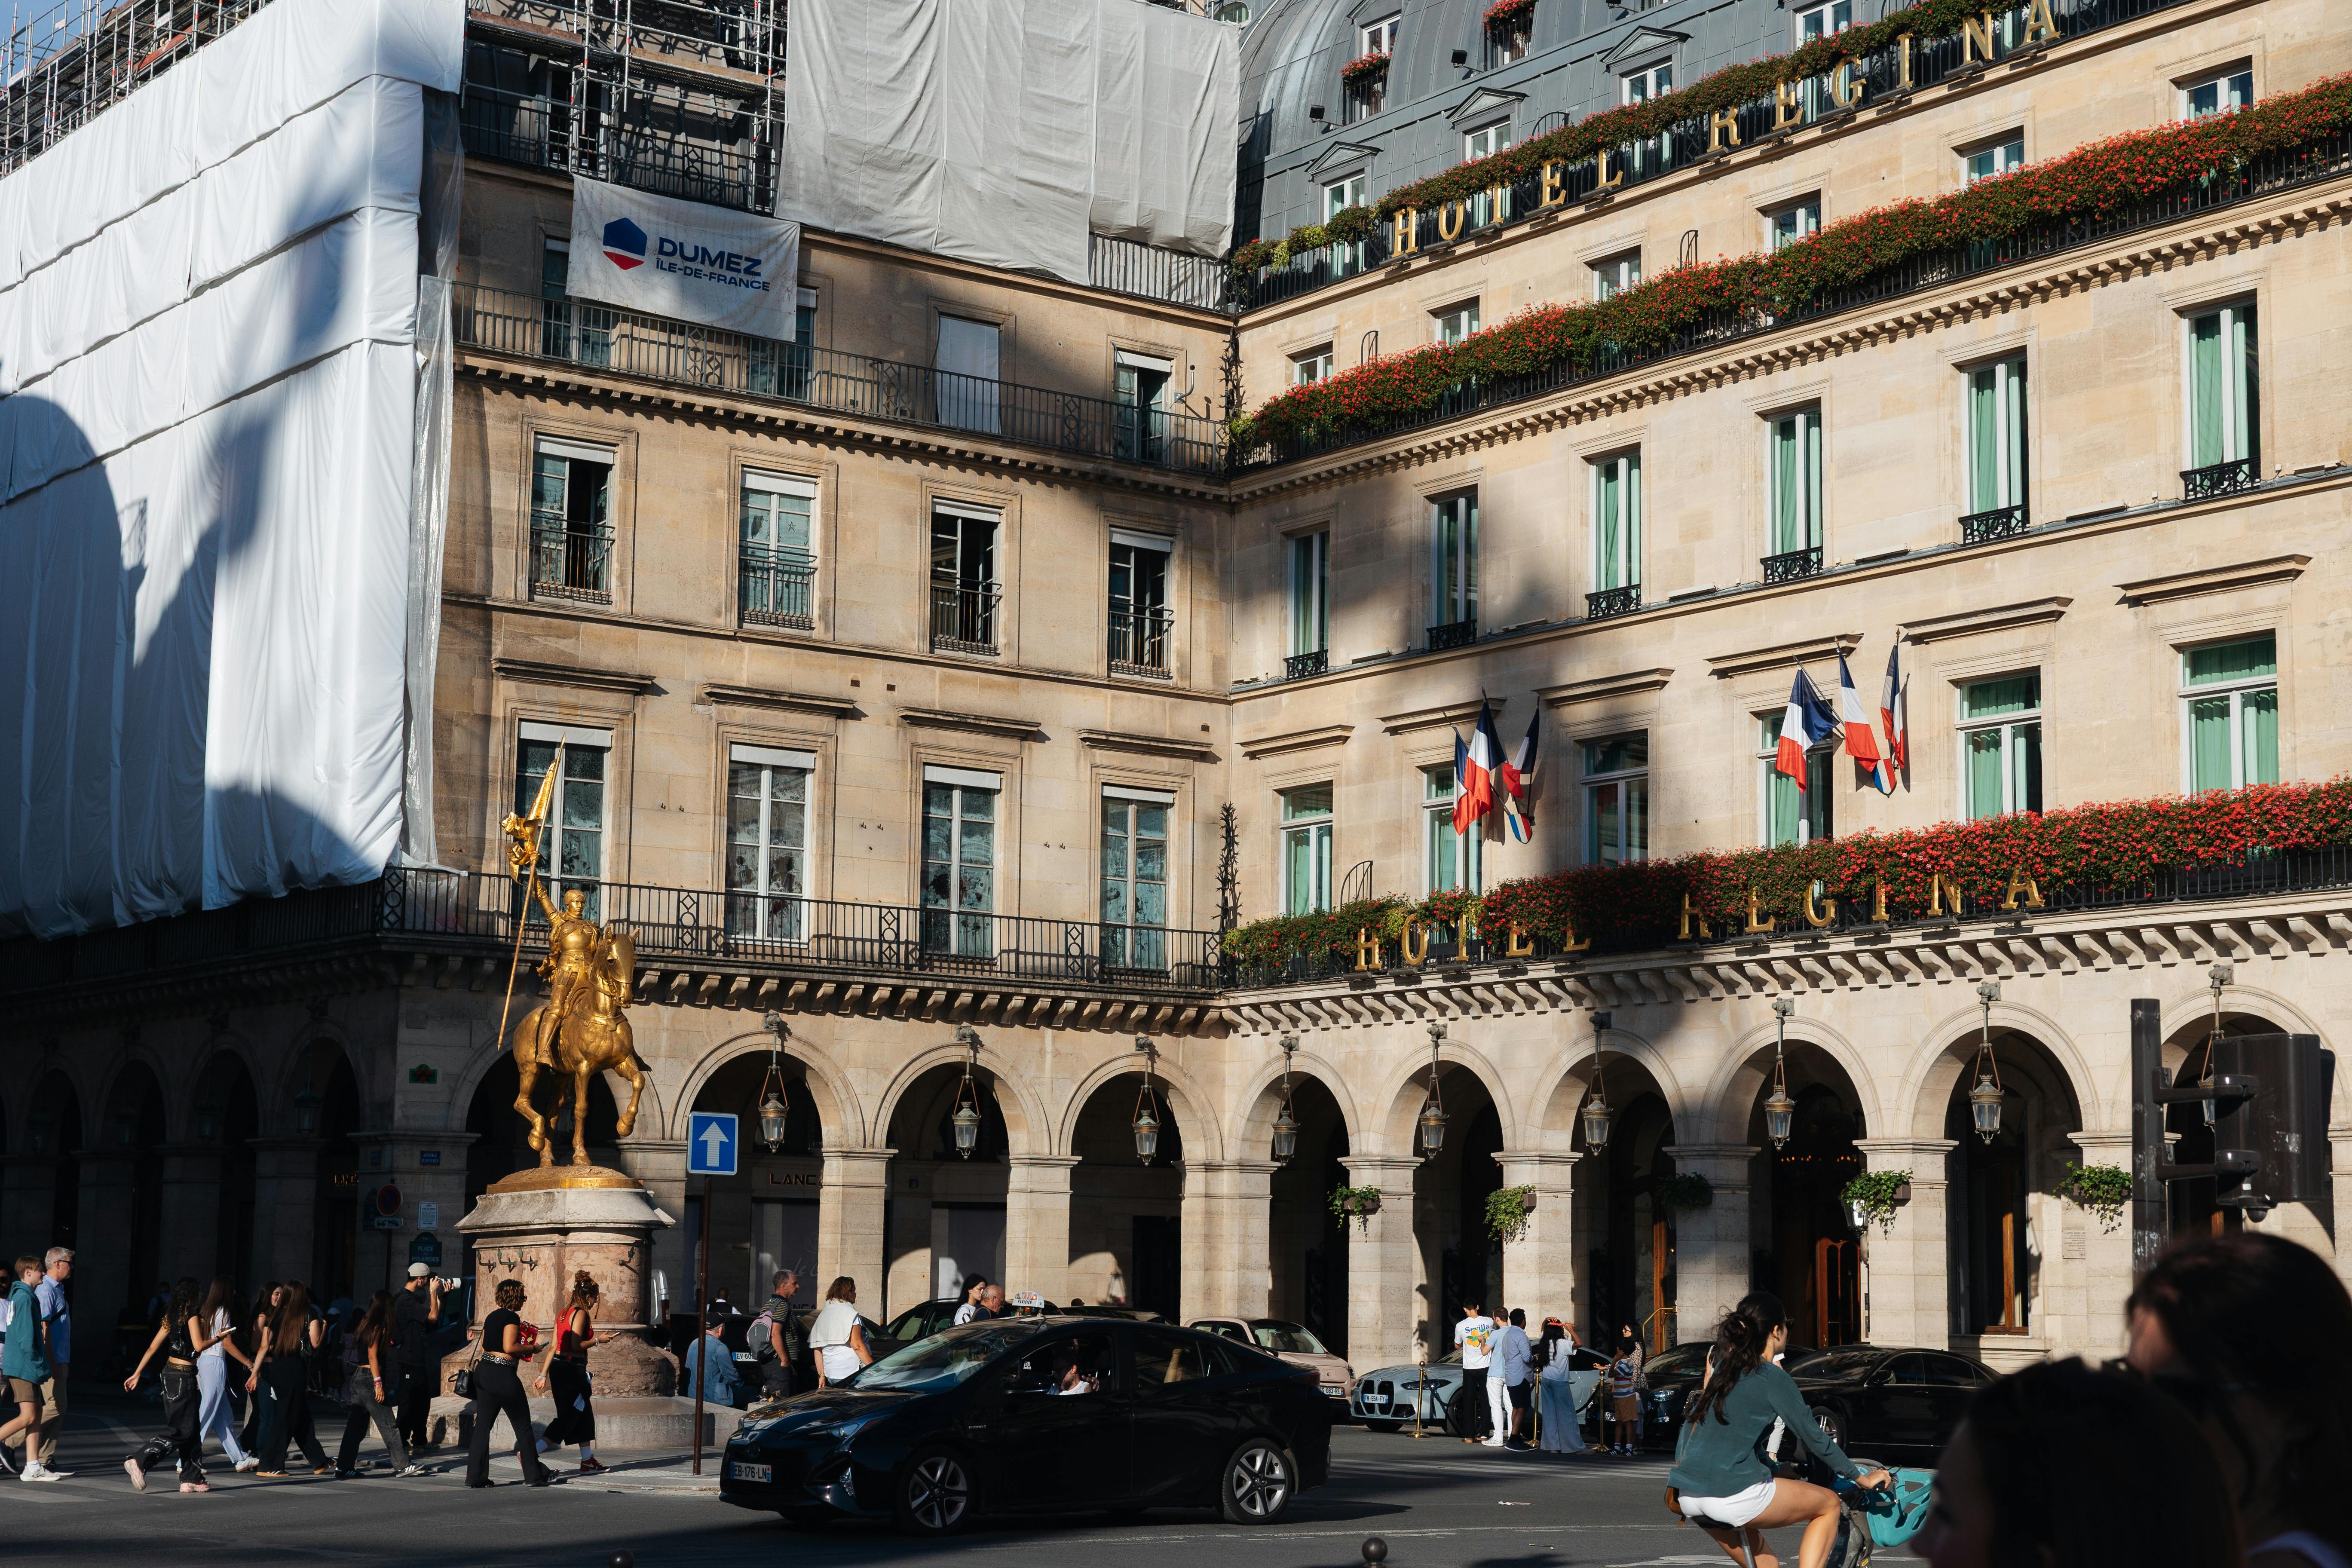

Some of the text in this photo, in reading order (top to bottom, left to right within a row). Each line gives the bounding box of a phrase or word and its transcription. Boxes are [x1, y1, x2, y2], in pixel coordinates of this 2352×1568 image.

[1707, 0, 2061, 153] REGINA
[658, 237, 762, 276] DUMEZ
[656, 257, 770, 292] ÎLE-DE-FRANCE
[1465, 1324, 1489, 1333] Sevilla
[734, 1464, 767, 1479] EB-176-LN
